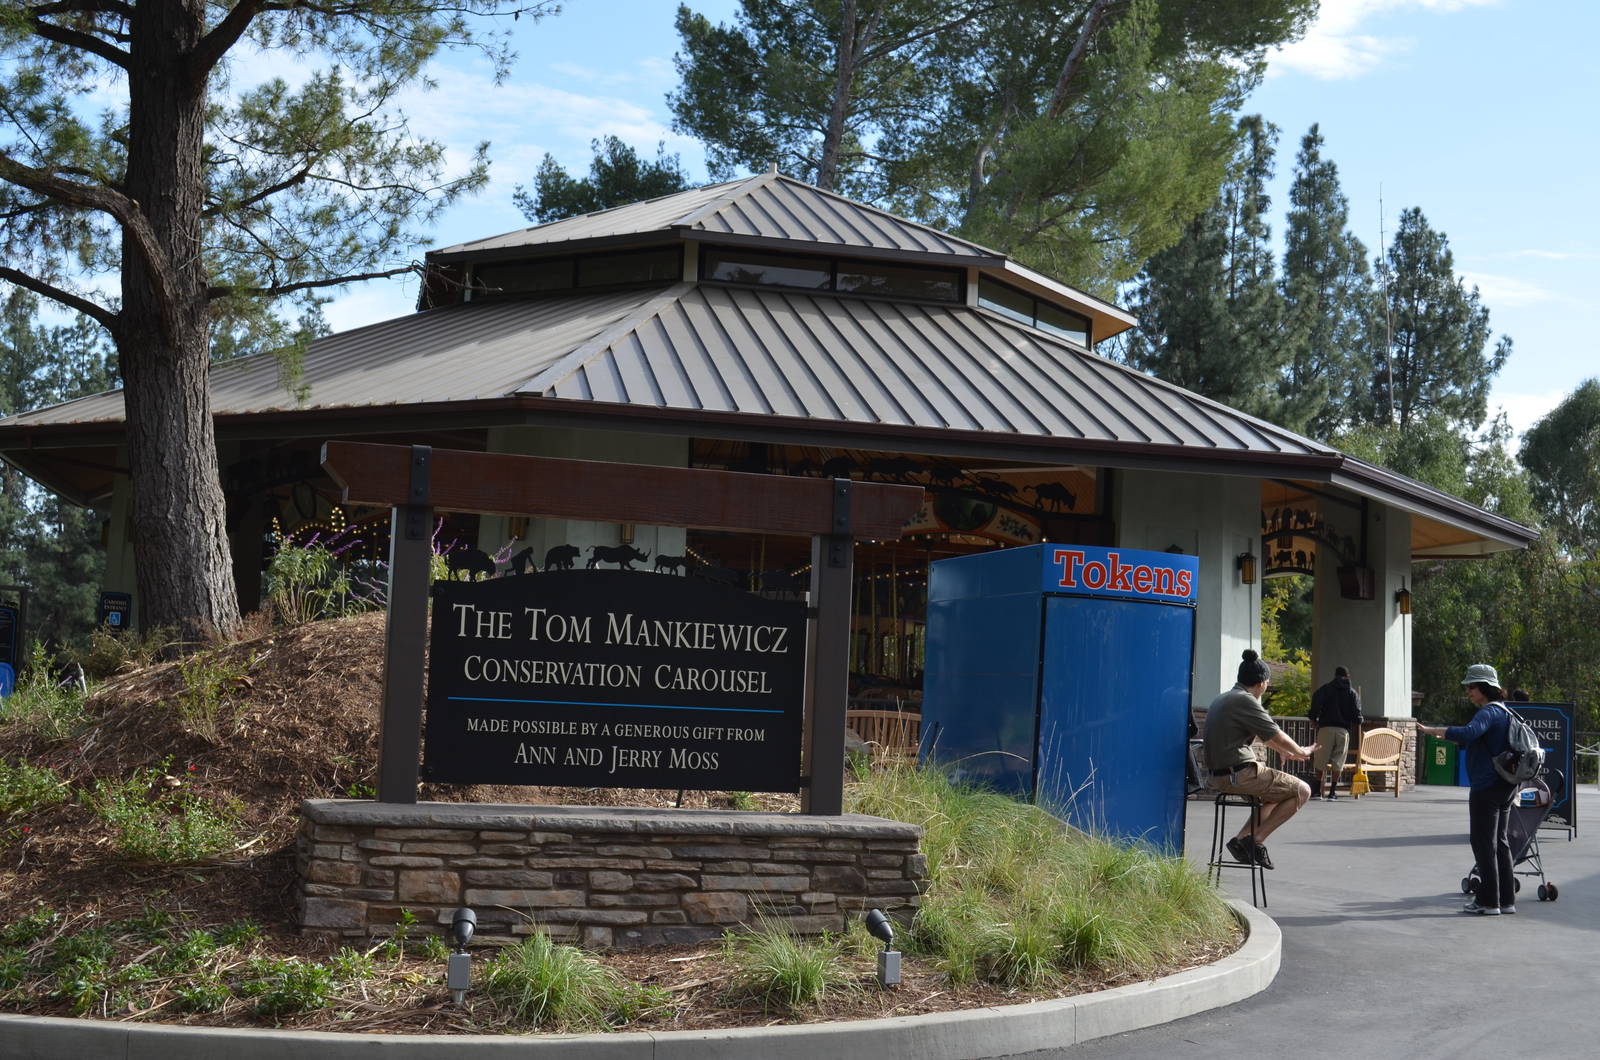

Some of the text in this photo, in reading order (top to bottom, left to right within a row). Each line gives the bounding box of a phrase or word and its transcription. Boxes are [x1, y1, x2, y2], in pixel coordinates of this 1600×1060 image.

[1053, 549, 1192, 598] Tokens
[453, 603, 787, 653] THE TOM MANKIEWICZ
[465, 656, 772, 693] CONSERVATION CAROUSEL
[468, 719, 764, 741] MADE POSSIBLE BY A GENEROUS GIFT FROM
[1524, 719, 1561, 730] OUSEL
[515, 743, 718, 773] ANN AND JERRY MOSS
